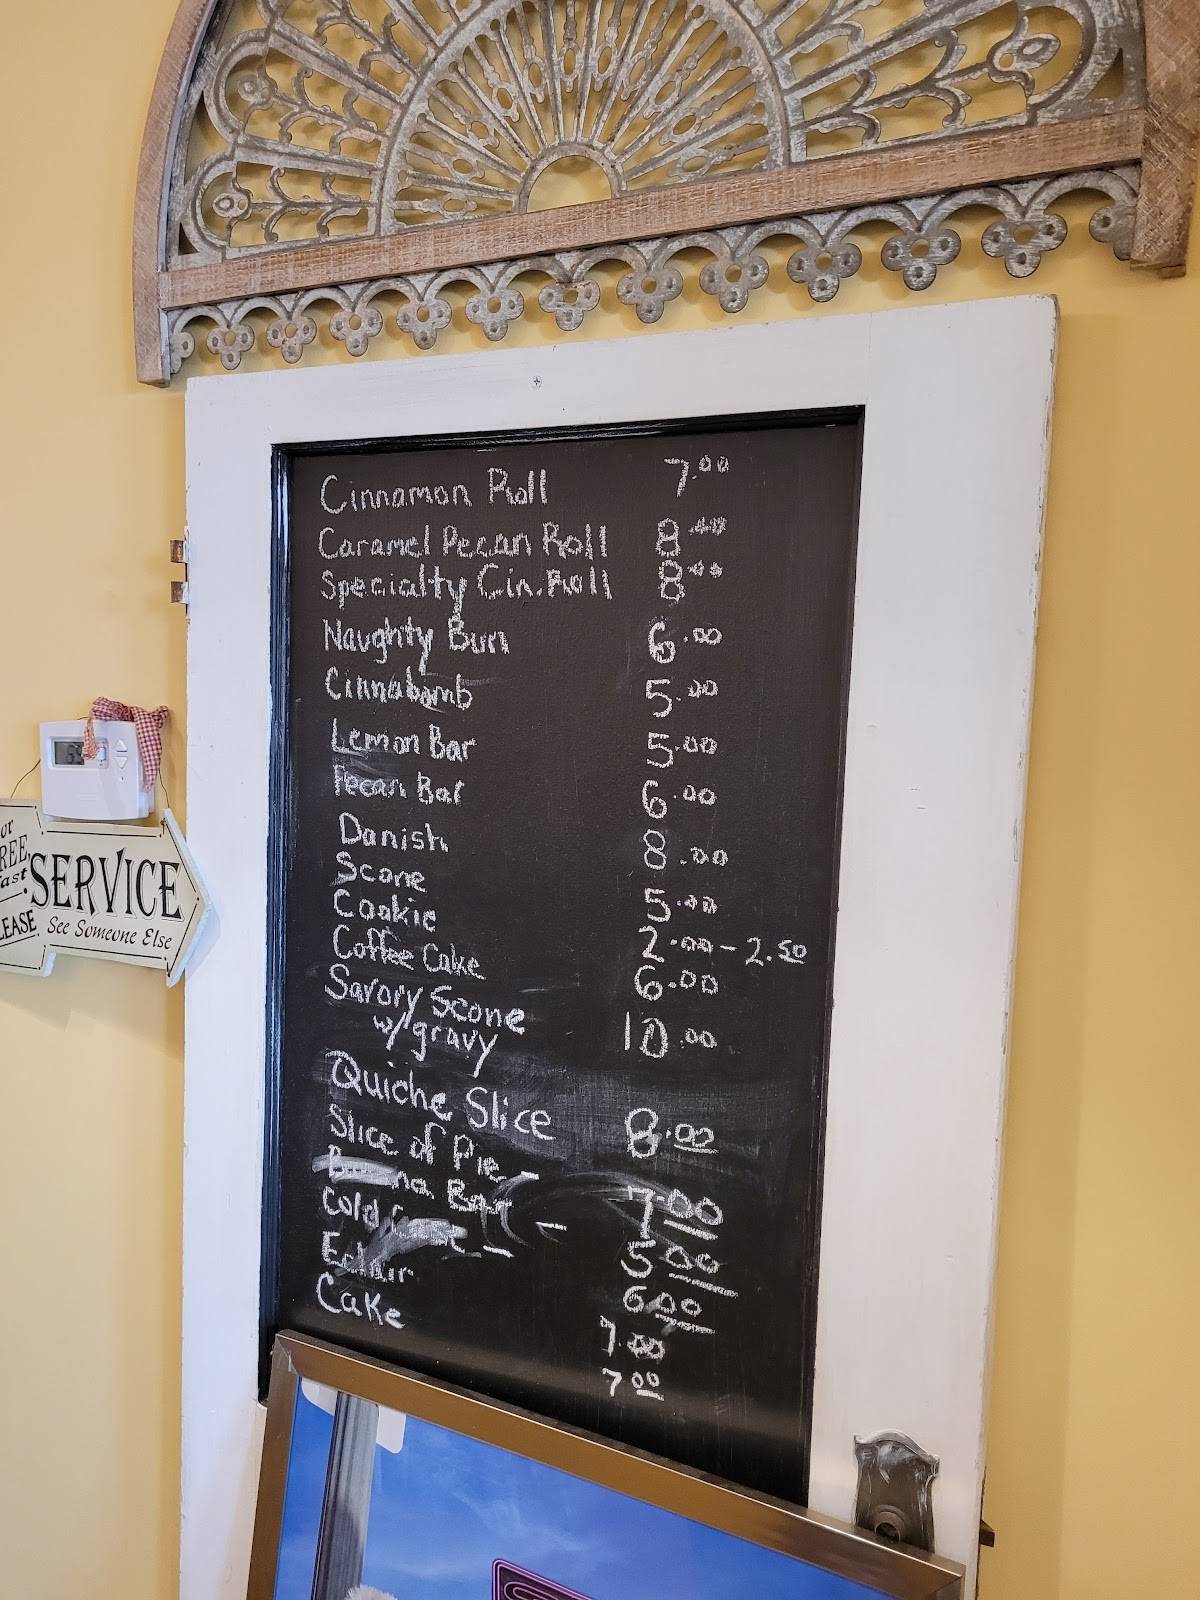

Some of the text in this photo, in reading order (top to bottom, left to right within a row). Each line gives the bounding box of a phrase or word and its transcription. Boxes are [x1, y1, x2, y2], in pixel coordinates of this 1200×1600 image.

[320, 474, 472, 515] Cinnamon
[487, 467, 549, 505] Roll
[318, 525, 431, 560] Caramel
[442, 524, 532, 559] Pecan
[542, 521, 609, 560] Roll
[320, 563, 468, 620] Specialty
[546, 566, 613, 600] Roll
[322, 617, 433, 675] Naughty
[448, 617, 510, 655] Bun
[331, 717, 718, 769] Lemon Bar 5.00
[333, 763, 718, 819] Pecan Bar 6.00
[338, 811, 729, 871] Danish 8.00
[0, 867, 28, 889] ast
[29, 847, 183, 921] SERVICE
[329, 850, 427, 893] Scone
[47, 915, 174, 951] See Someone Else
[333, 888, 437, 933] Cookie
[332, 924, 719, 1001] Coffee Cake 6.00
[324, 963, 526, 1036] Savory Scone
[324, 1049, 720, 1159] Quiche Slice 8.00
[327, 1102, 399, 1156] Slice
[409, 1121, 447, 1166] of
[453, 1133, 507, 1183] Pie
[322, 1185, 380, 1229] Cold
[316, 1271, 406, 1330] Cake
